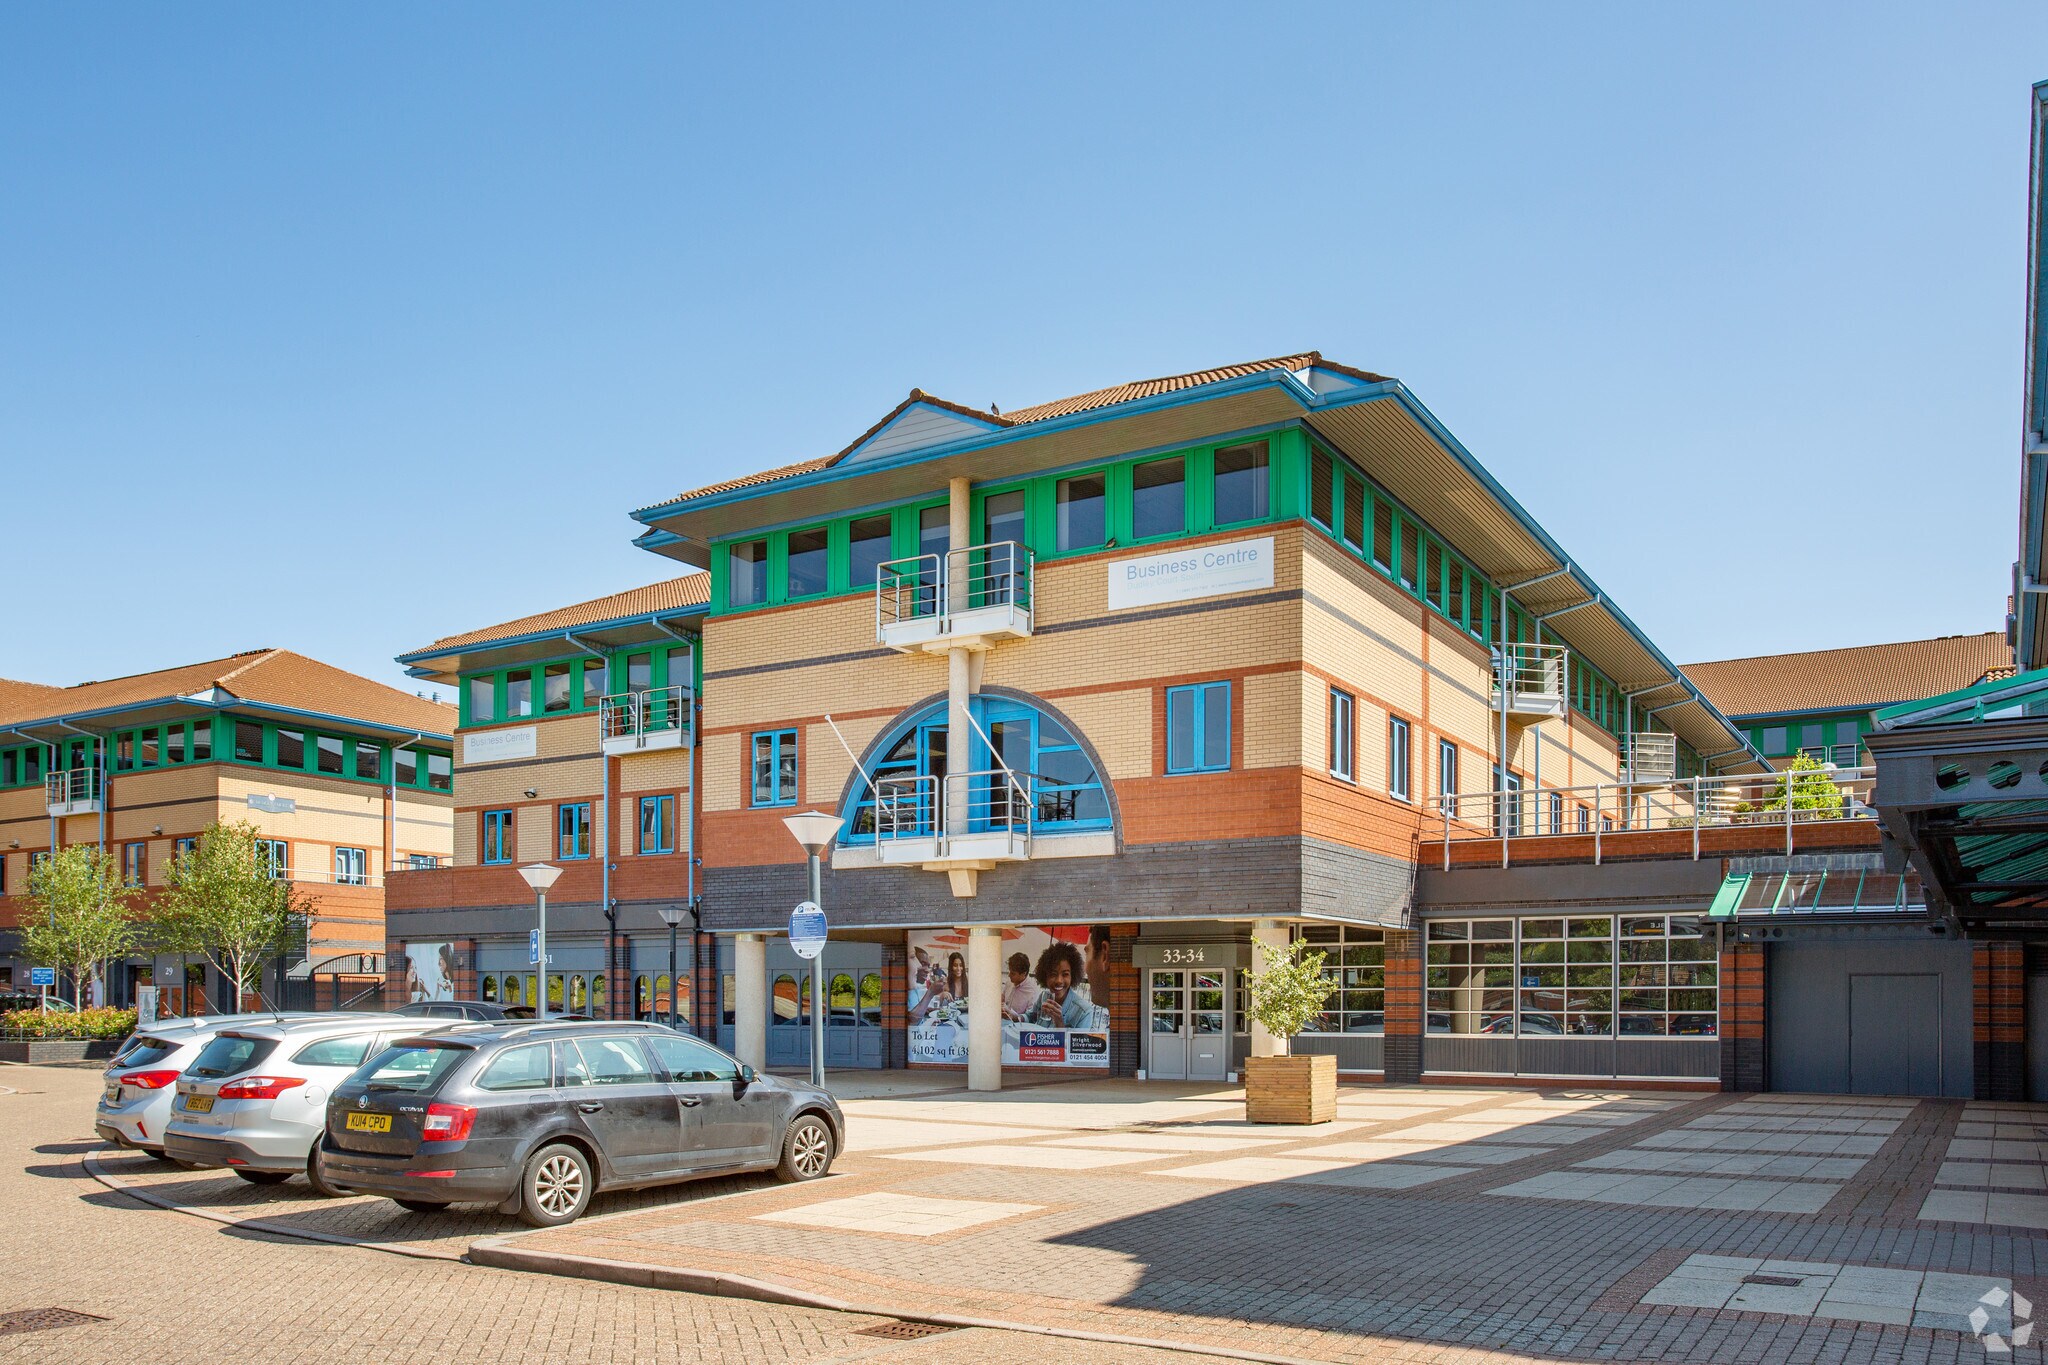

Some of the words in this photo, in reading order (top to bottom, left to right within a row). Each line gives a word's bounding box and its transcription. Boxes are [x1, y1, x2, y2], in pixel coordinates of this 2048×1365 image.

[1127, 558, 1197, 580] Business
[1203, 549, 1258, 568] Centre
[471, 736, 503, 747] Business
[505, 733, 530, 743] Centre
[1163, 947, 1205, 963] 33-34
[23, 970, 30, 978] 28
[165, 967, 174, 976] 29
[912, 1031, 923, 1040] To
[925, 1031, 938, 1040] Let
[912, 1045, 935, 1055] 4,102
[937, 1048, 946, 1058] sq
[948, 1046, 955, 1055] ft
[957, 1046, 969, 1056] (38
[351, 1114, 367, 1128] KU14
[368, 1115, 386, 1129] CPO
